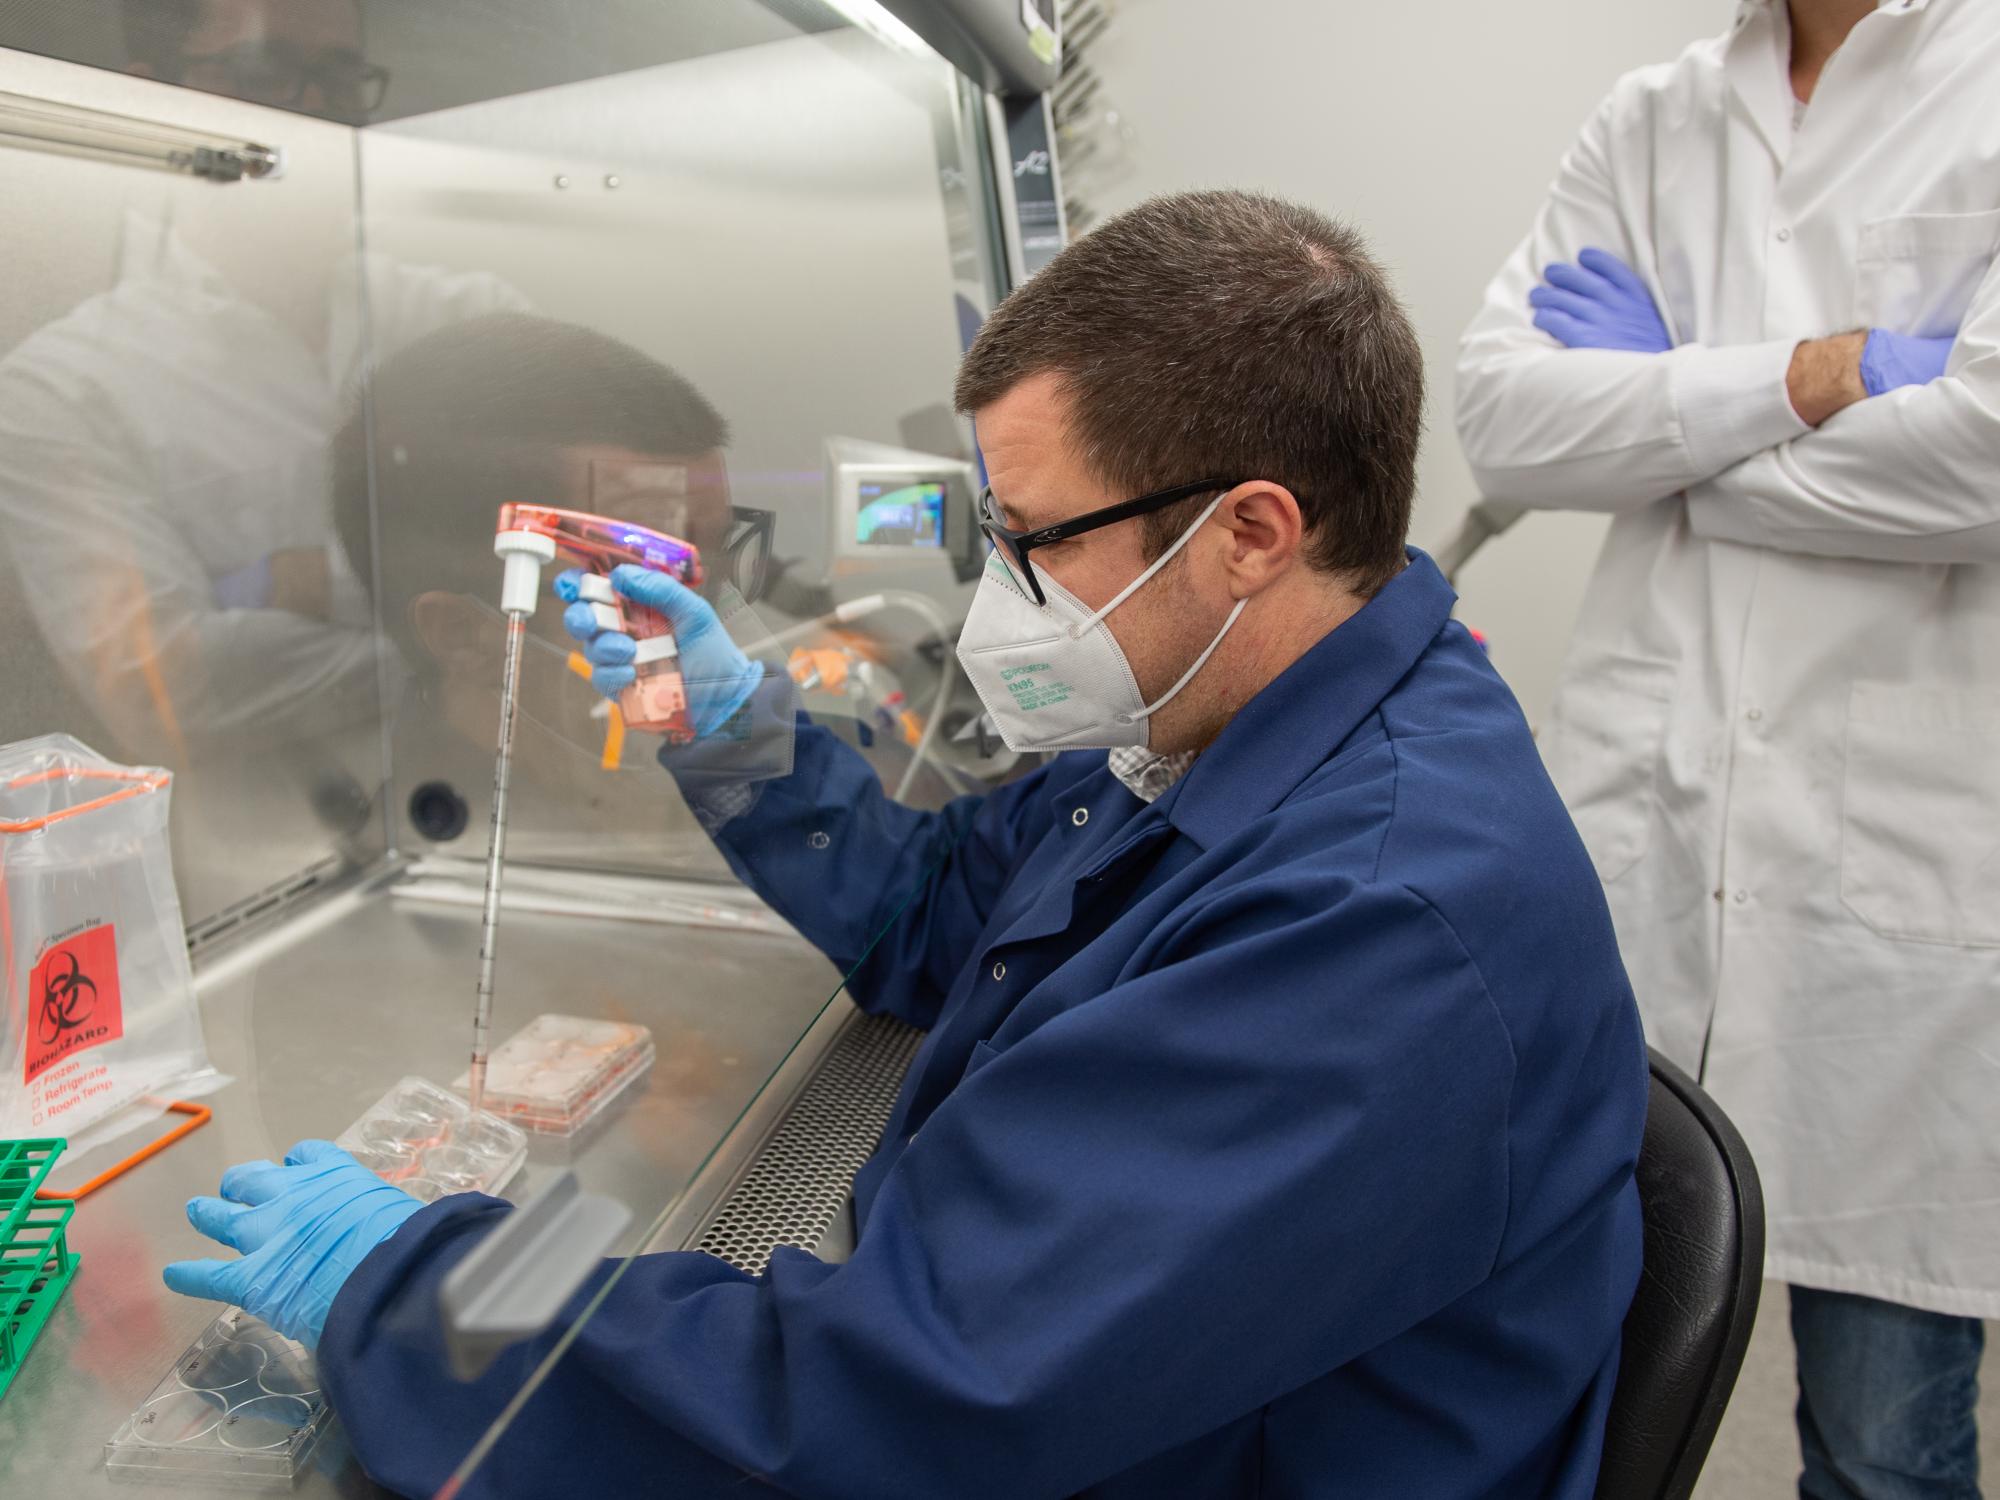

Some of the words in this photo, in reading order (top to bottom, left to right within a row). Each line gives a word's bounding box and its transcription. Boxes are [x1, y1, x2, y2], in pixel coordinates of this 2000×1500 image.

[1008, 678, 1034, 692] KN95
[28, 1025, 109, 1074] BIOHAZARD
[44, 1061, 80, 1086] Frozen
[45, 1066, 108, 1102] Refrigerate
[48, 1096, 80, 1118] Room
